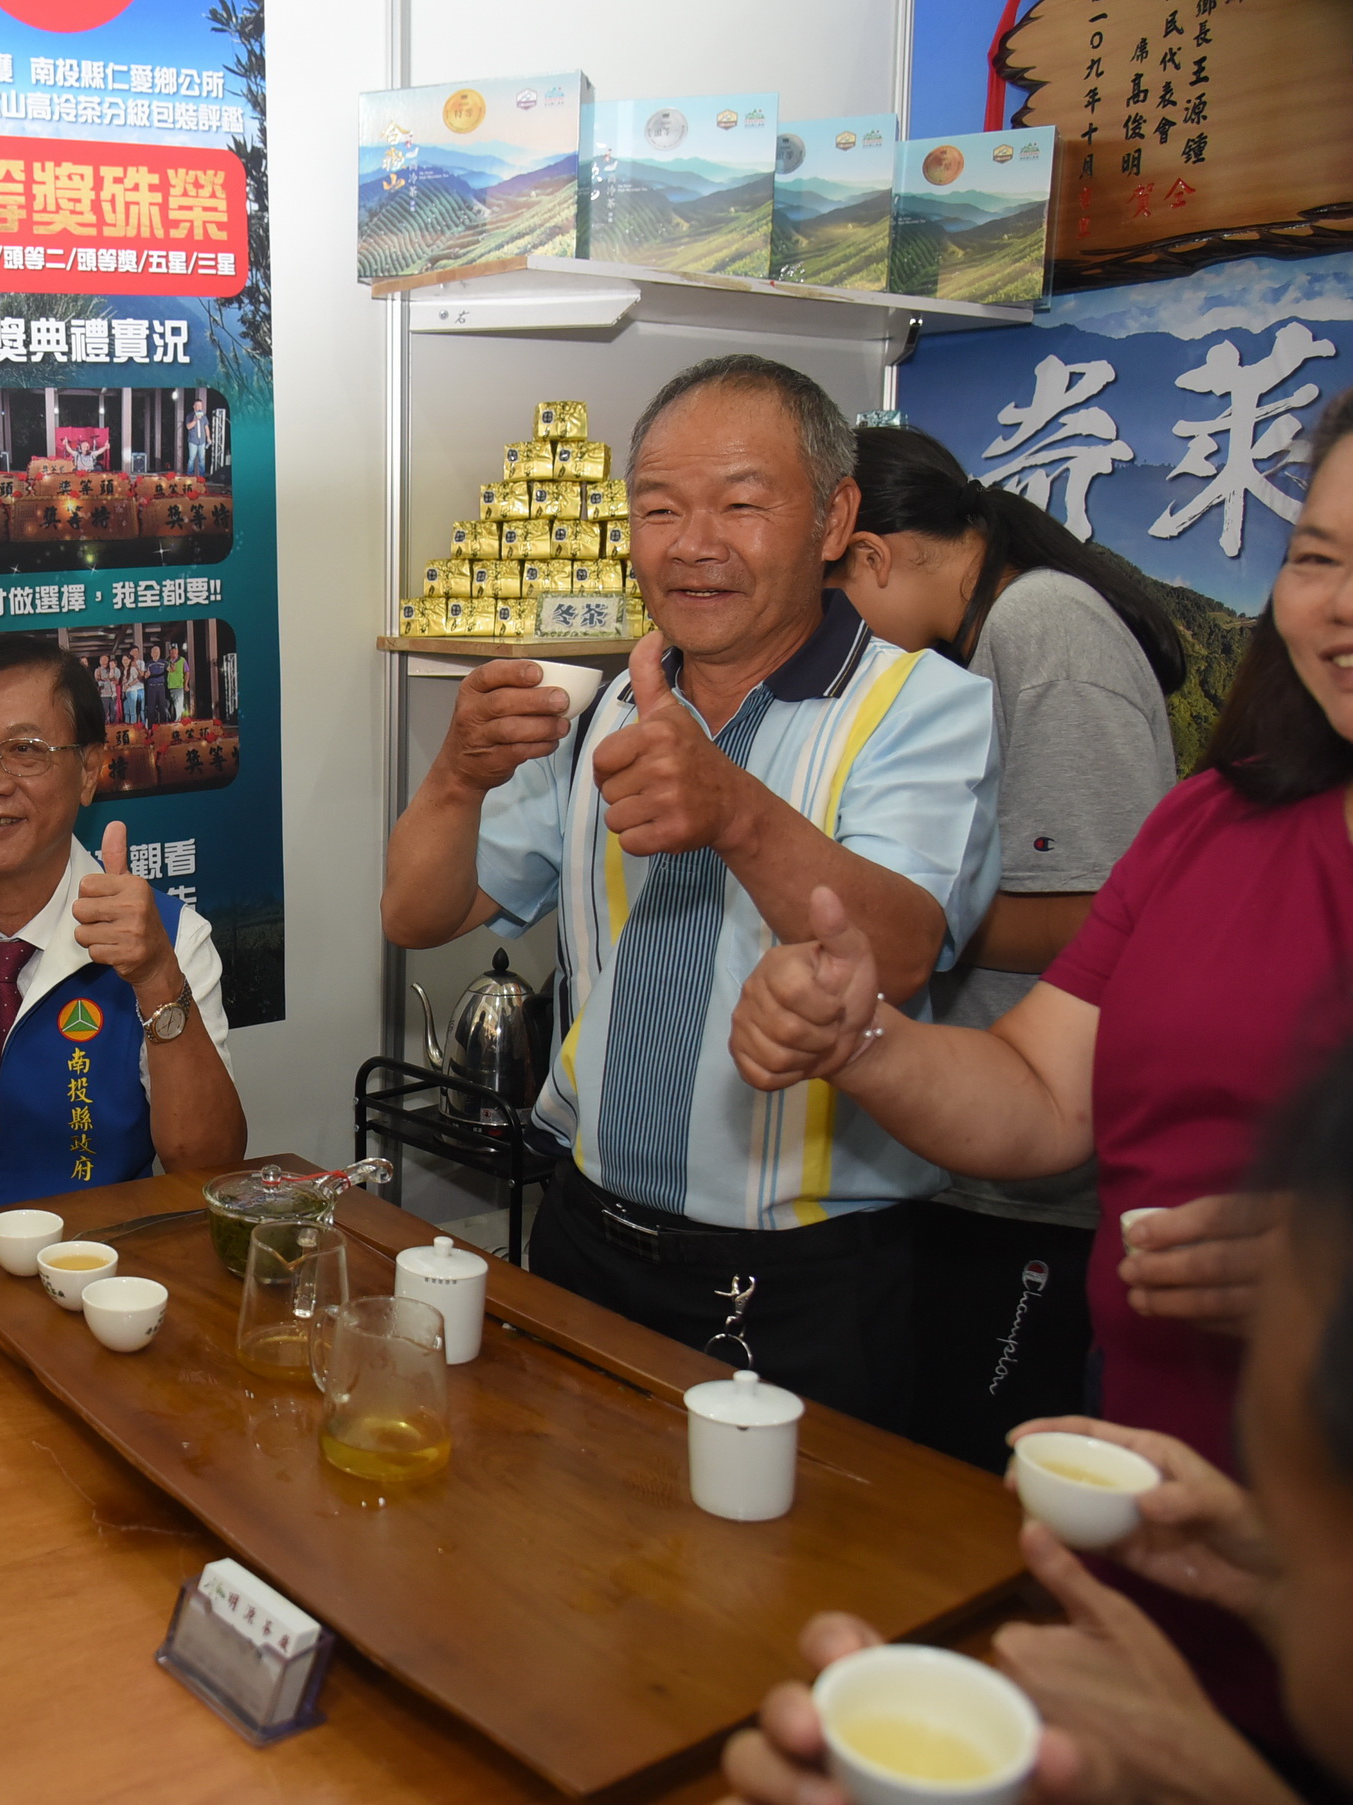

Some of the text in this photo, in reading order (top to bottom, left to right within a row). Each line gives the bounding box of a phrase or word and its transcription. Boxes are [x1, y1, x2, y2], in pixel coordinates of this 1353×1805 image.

[29, 56, 226, 99] 南投縣仁愛鄉公所
[552, 603, 609, 626] 冬茶
[66, 1047, 97, 1183] 南投縣政府
